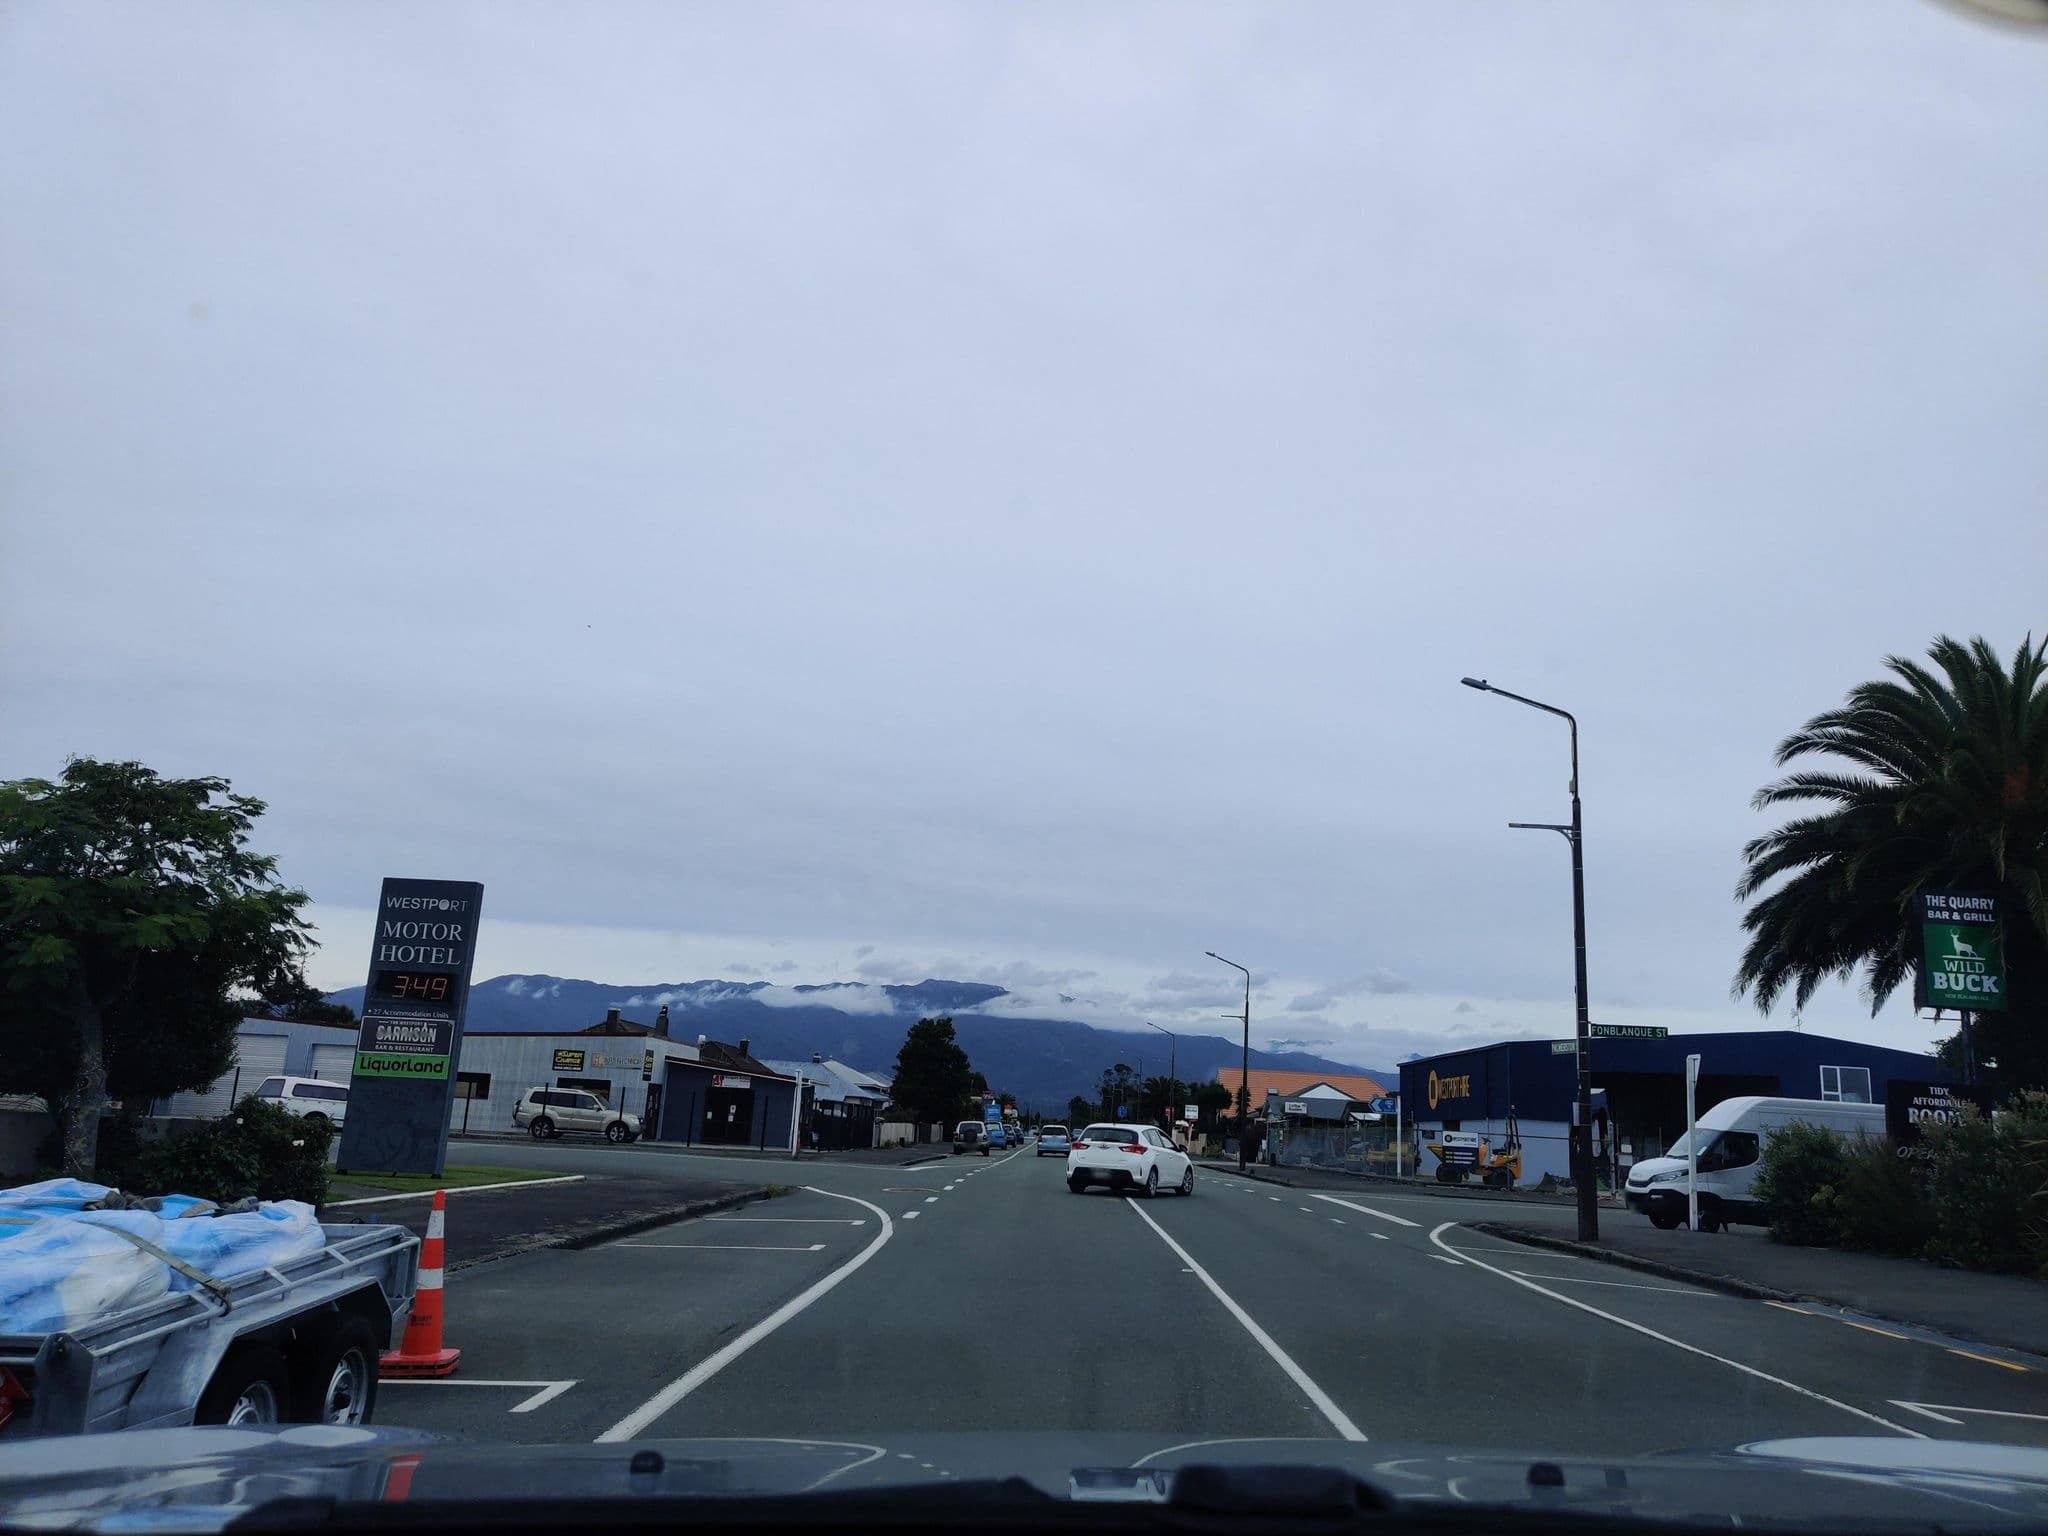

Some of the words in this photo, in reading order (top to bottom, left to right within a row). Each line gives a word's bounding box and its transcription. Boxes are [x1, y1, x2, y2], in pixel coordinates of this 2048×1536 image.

[387, 896, 469, 912] WESTPORT
[1926, 895, 1946, 908] THE
[1949, 896, 1995, 910] QUARRY
[1928, 910, 1950, 920] BAR
[1952, 911, 1961, 920] &
[1964, 912, 1995, 922] GRILL
[383, 921, 463, 942] MOTOR
[379, 944, 462, 966] HOTEL
[1944, 960, 1985, 973] WILD
[392, 975, 448, 1000] 3:49
[1932, 972, 2000, 993] BUCK
[382, 1009, 432, 1018] Accommodation
[1591, 1026, 1653, 1038] FONBLANQUE
[1656, 1028, 1666, 1038] ST
[394, 1045, 434, 1053] RESTAURANT
[1928, 1086, 1950, 1095] TIDY
